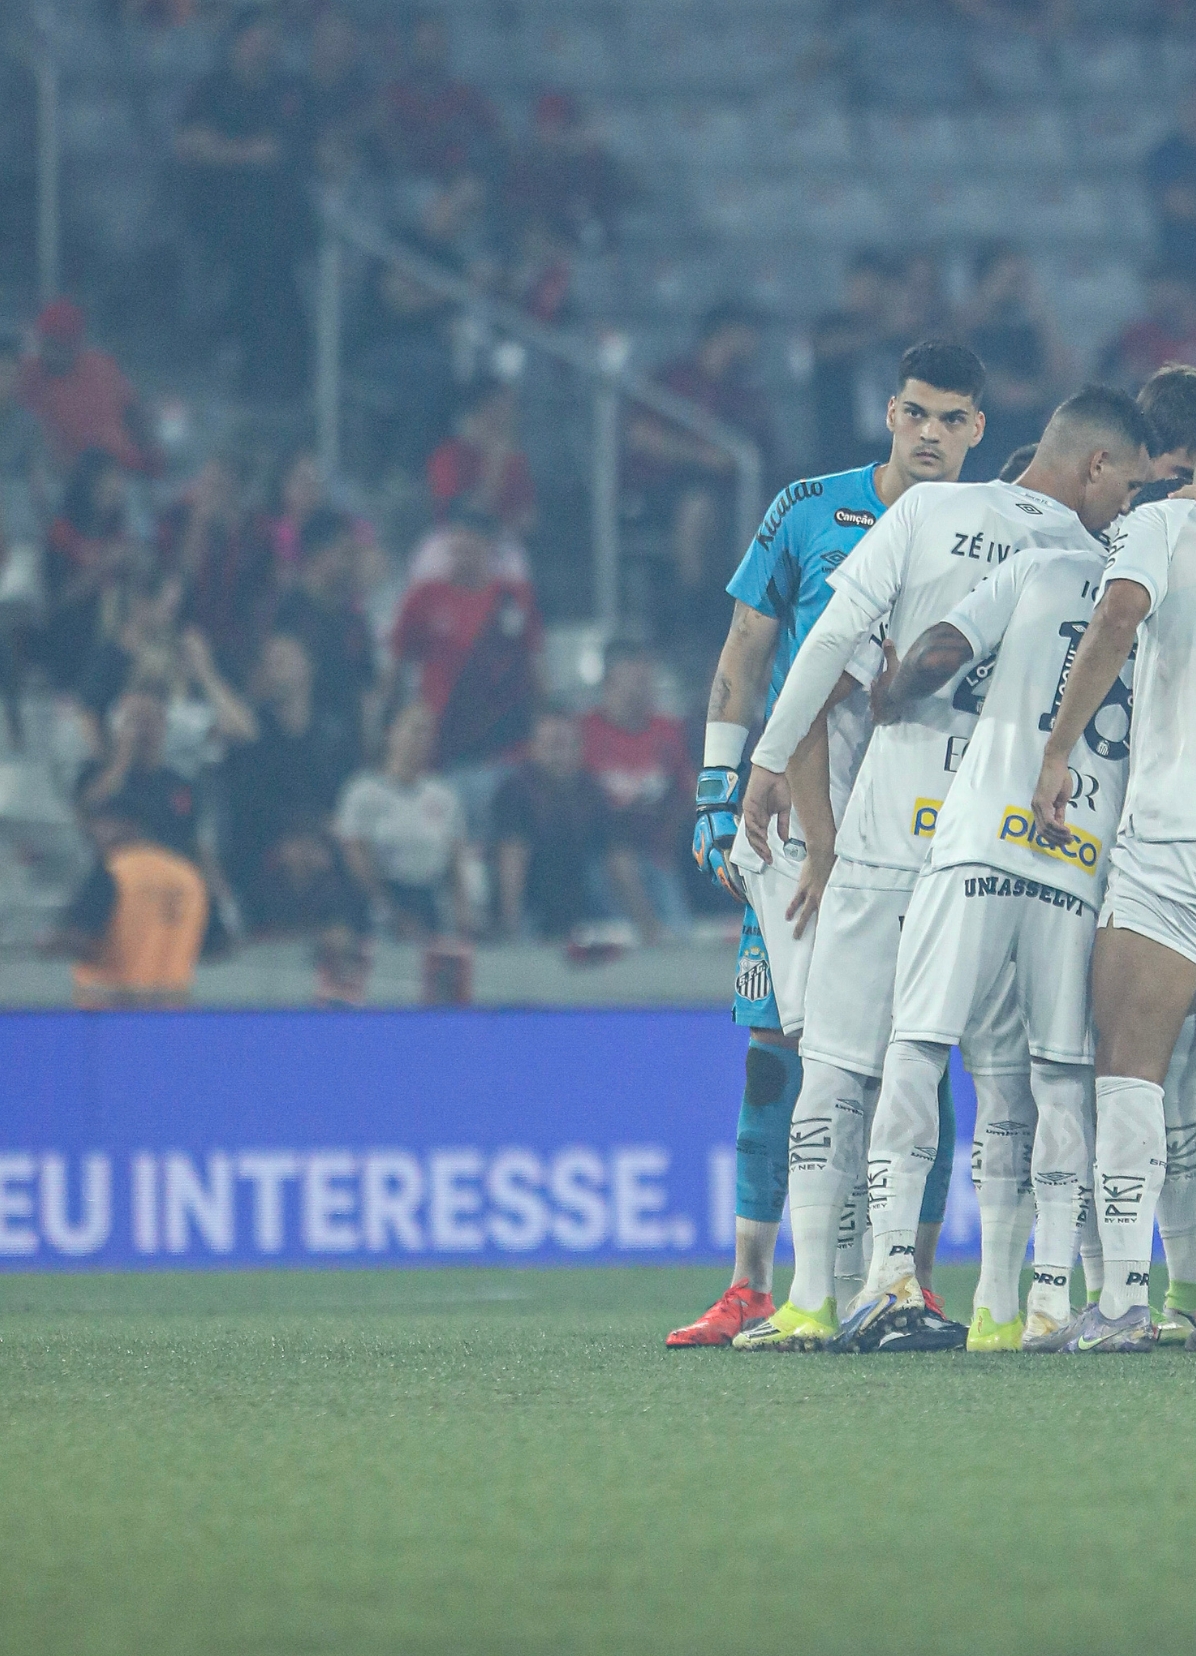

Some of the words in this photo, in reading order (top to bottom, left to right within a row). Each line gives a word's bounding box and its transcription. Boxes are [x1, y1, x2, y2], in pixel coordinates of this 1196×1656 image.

[836, 510, 876, 527] Canção
[131, 1148, 694, 1254] INTERESSE.
[889, 1245, 915, 1257] PR
